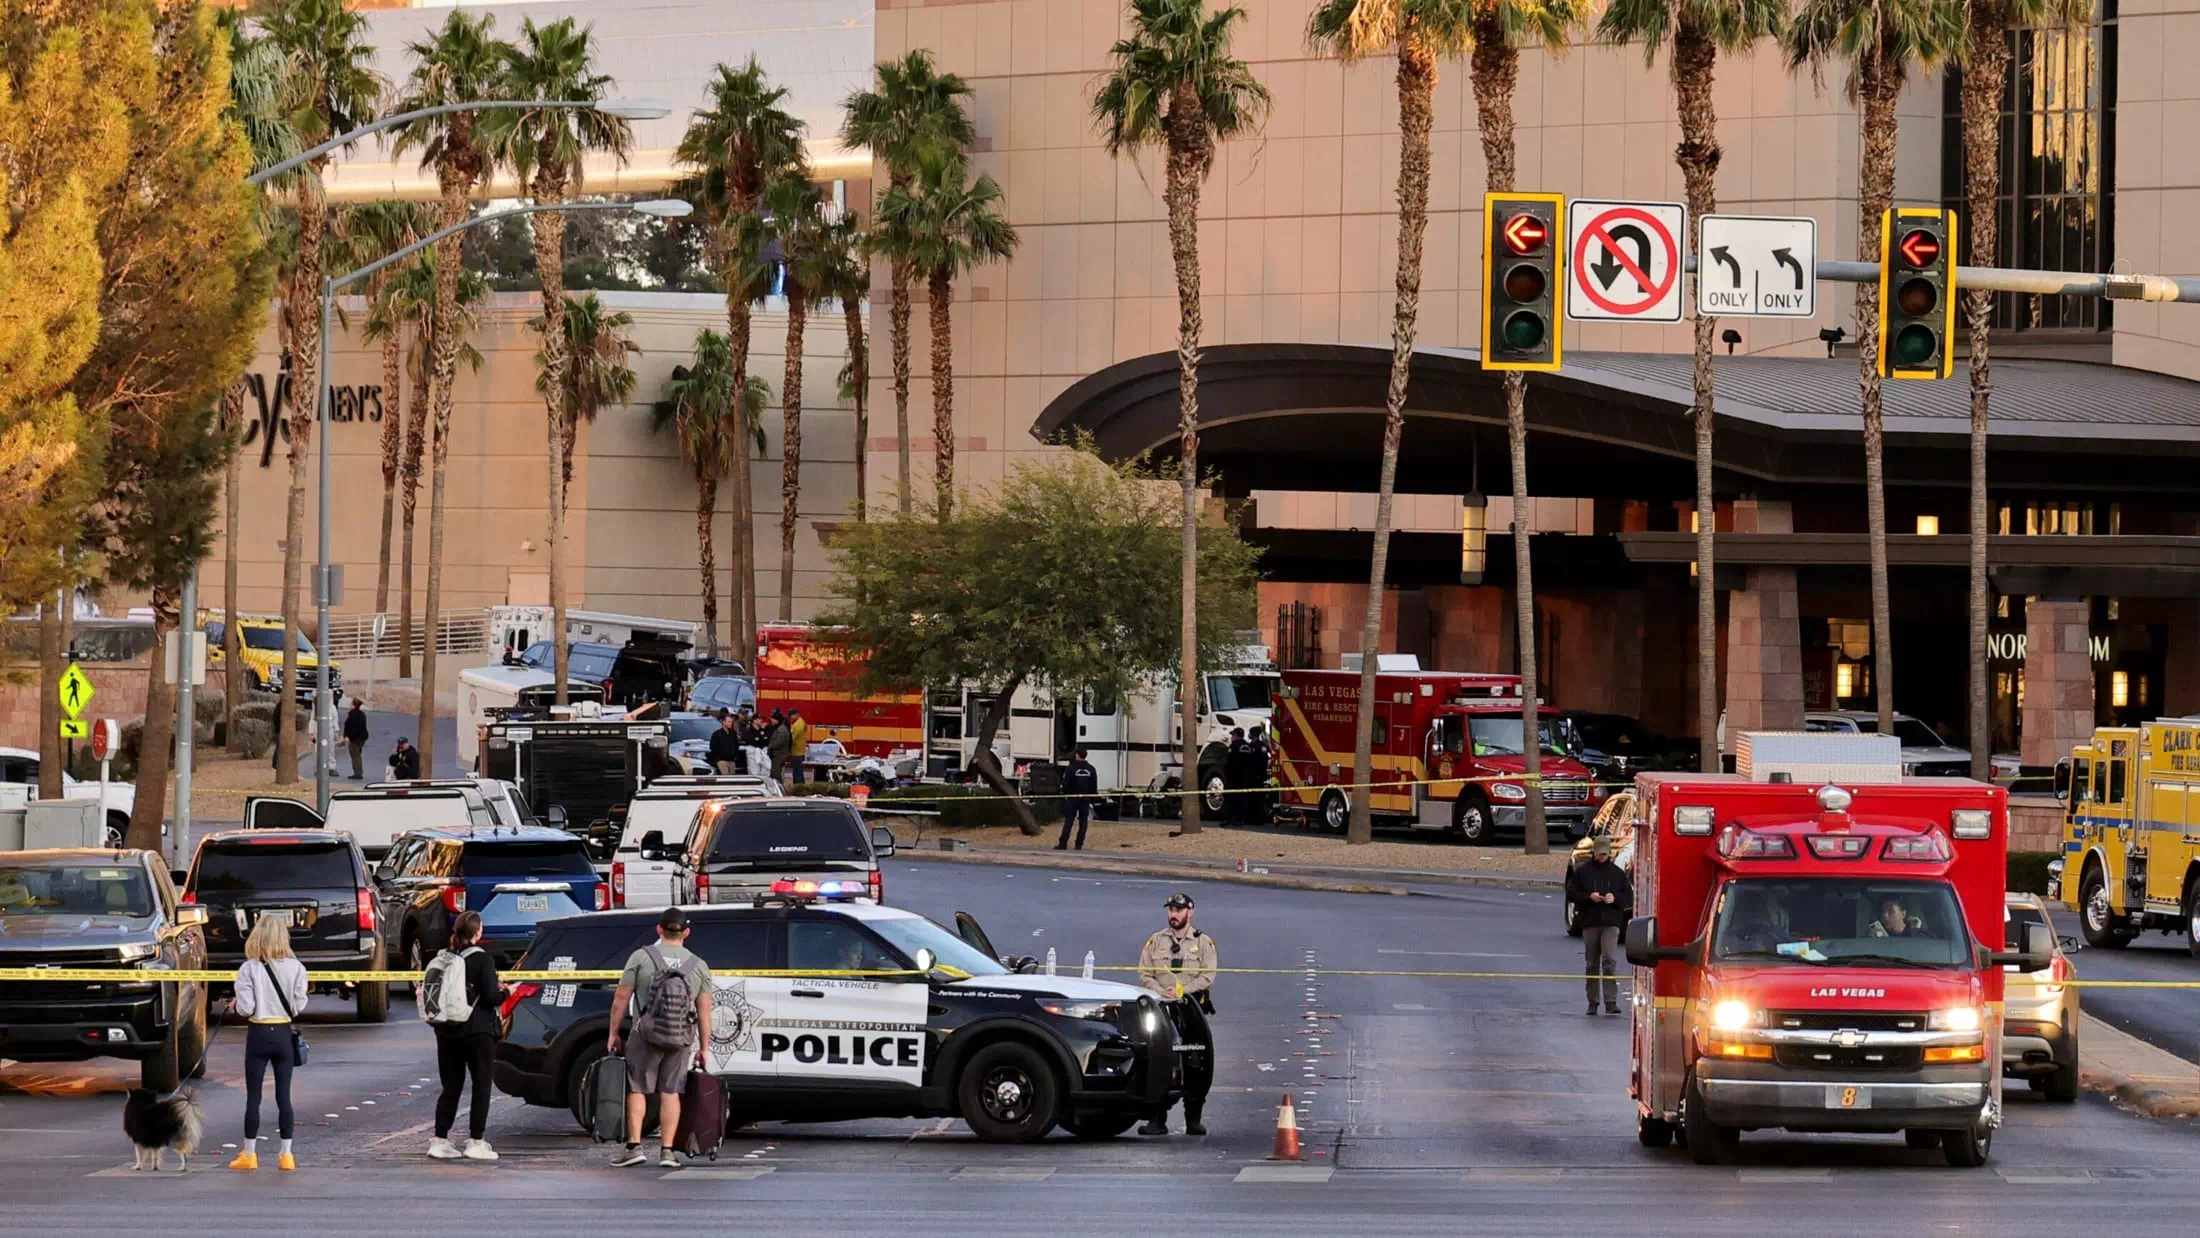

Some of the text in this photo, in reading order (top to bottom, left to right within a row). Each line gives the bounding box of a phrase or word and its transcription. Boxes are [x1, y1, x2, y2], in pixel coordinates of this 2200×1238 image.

[1709, 292, 1748, 307] ONLY
[1764, 293, 1803, 308] ONLY
[1304, 685, 1361, 698] LAS VEGAS
[1304, 701, 1321, 711] FIRE
[1333, 702, 1358, 712] RESCU
[1399, 729, 1405, 741] 3
[2163, 729, 2192, 752] CLARK
[792, 979, 880, 990] TACTICAL VEHICLE
[1810, 988, 1885, 997] LAS VEGAS
[763, 1019, 917, 1032] LAS VEGAS METROPOLITAN
[761, 1033, 919, 1067] POLICE
[1841, 1087, 1857, 1108] 8
